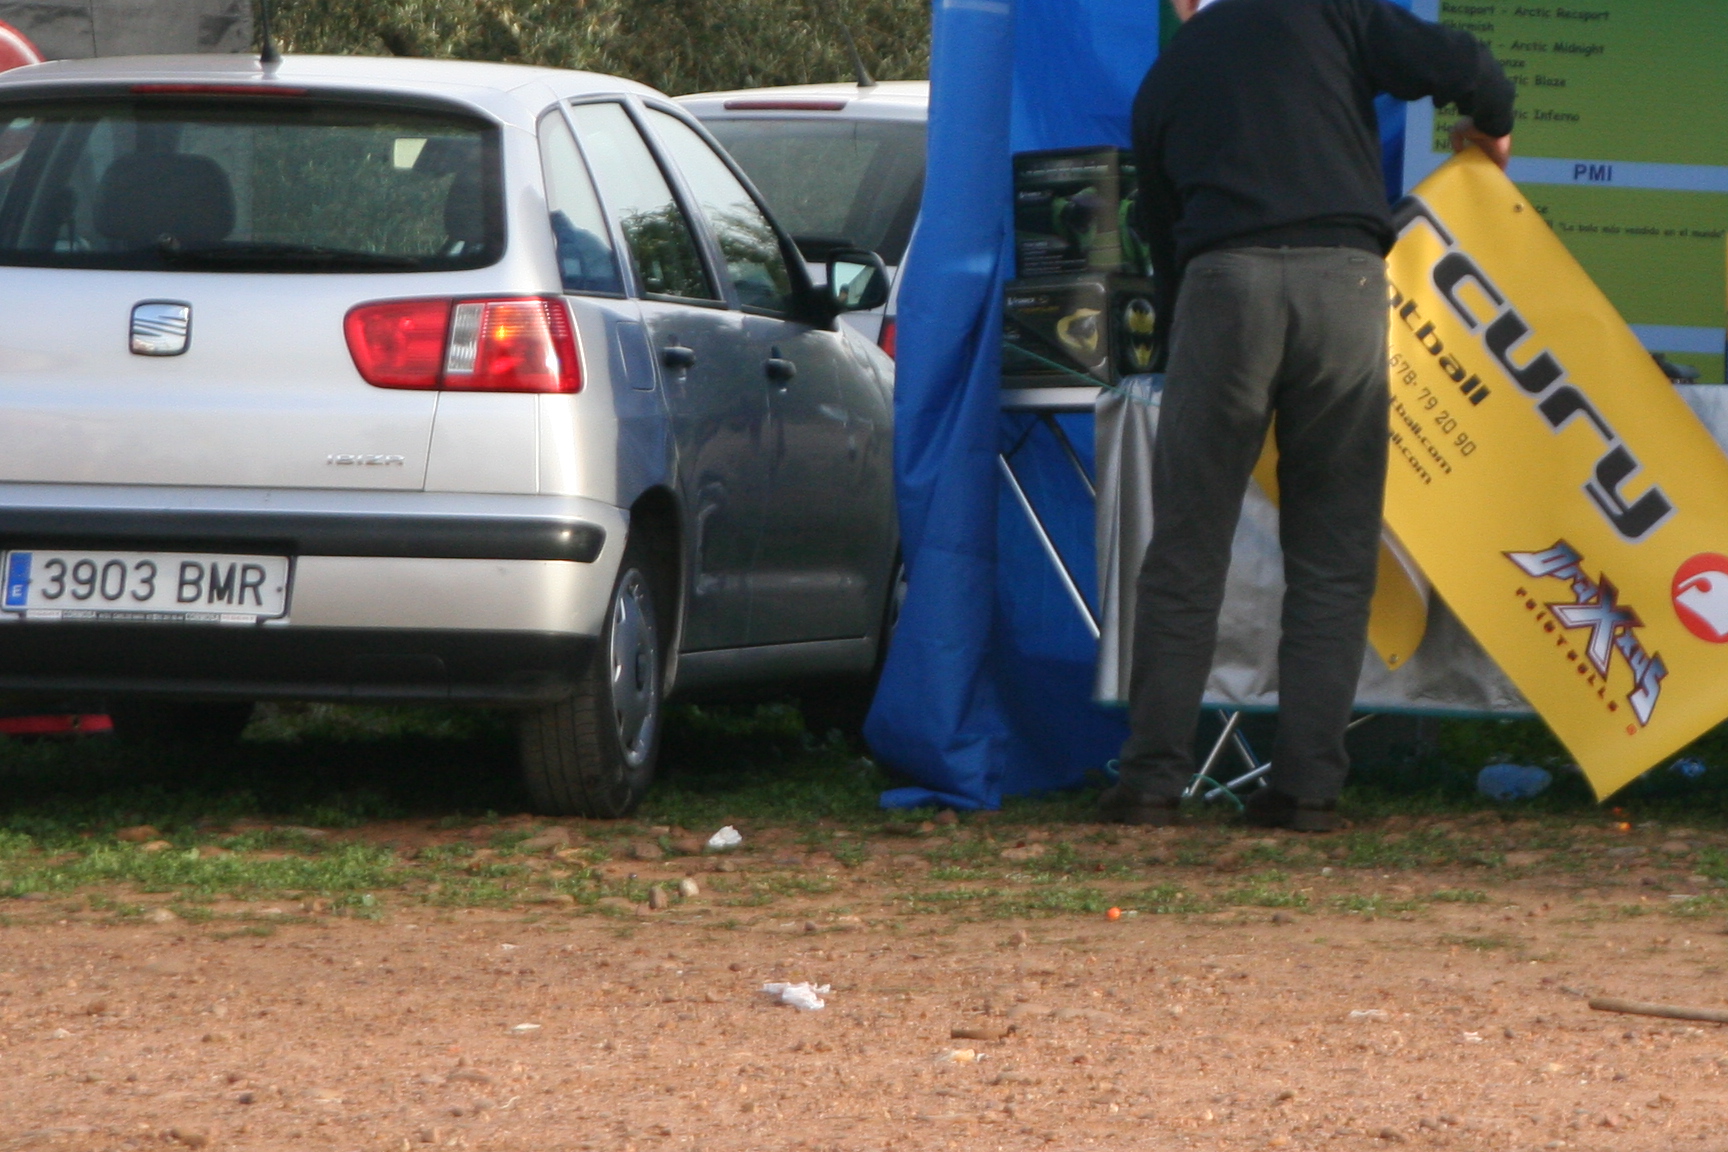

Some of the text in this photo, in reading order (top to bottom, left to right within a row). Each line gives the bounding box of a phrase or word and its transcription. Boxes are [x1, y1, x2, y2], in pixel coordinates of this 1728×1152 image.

[1574, 164, 1613, 182] PMI
[1418, 386, 1438, 410] 79
[1435, 410, 1457, 435] 20
[1454, 432, 1477, 457] 90
[41, 557, 268, 606] 3903 BMR
